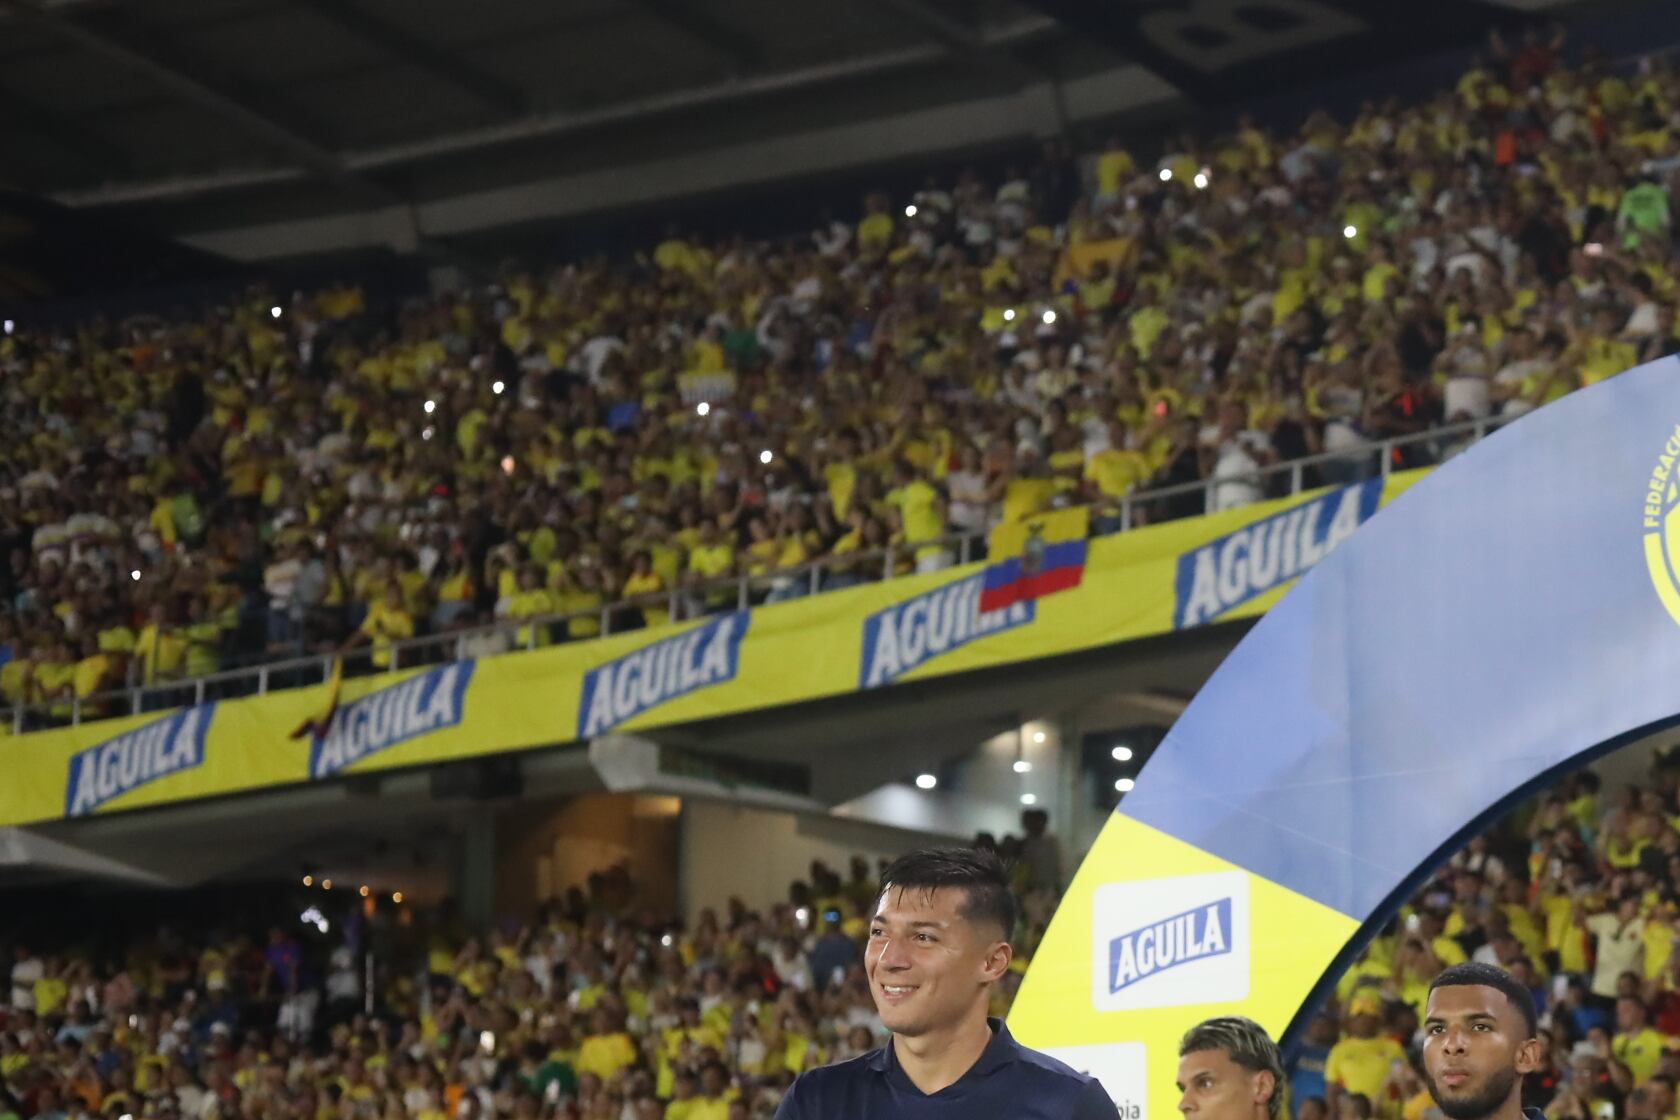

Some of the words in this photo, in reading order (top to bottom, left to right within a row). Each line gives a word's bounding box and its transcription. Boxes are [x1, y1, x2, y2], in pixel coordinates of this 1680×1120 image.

[1183, 484, 1363, 628] AGUILA
[583, 616, 734, 737] AGUILA
[866, 576, 1027, 688] AGUIL
[70, 705, 201, 816] AGUILA
[315, 663, 459, 778] AGUILA
[1115, 904, 1225, 988] AGUILA
